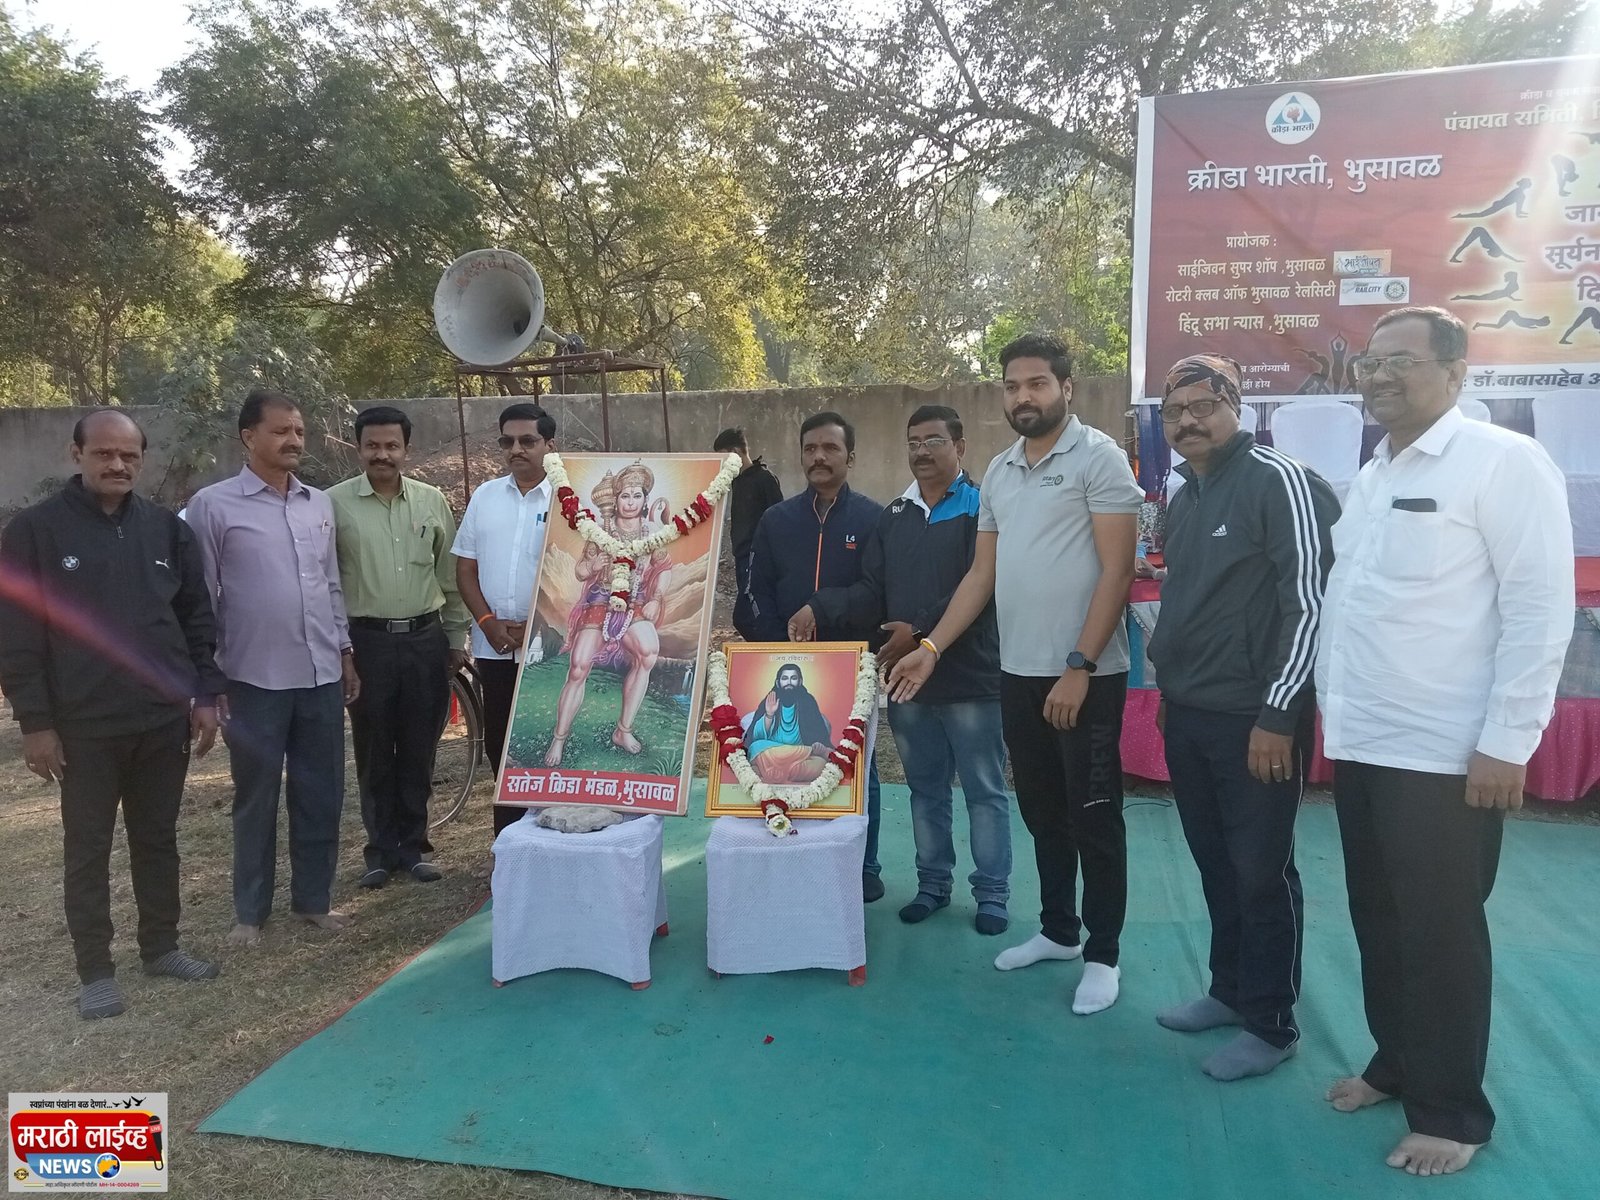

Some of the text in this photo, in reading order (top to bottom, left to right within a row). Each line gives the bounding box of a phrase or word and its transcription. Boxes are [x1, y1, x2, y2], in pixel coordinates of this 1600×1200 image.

[1444, 111, 1509, 131] पंचायत
[1188, 154, 1443, 193] क्रीडा भारती, भुसावळ
[1226, 231, 1271, 248] प्रायोजक
[1177, 258, 1227, 279] साईजिवन
[1230, 261, 1252, 279] सुपर
[1256, 257, 1278, 274] शॉप
[1165, 280, 1336, 304] रोटरी क्लब ऑफ भुसावळ रेलसिटी
[1178, 312, 1203, 336] हिंदू
[1203, 316, 1230, 331] सभा
[1233, 315, 1264, 330] न्यास
[507, 771, 545, 793] सतेज
